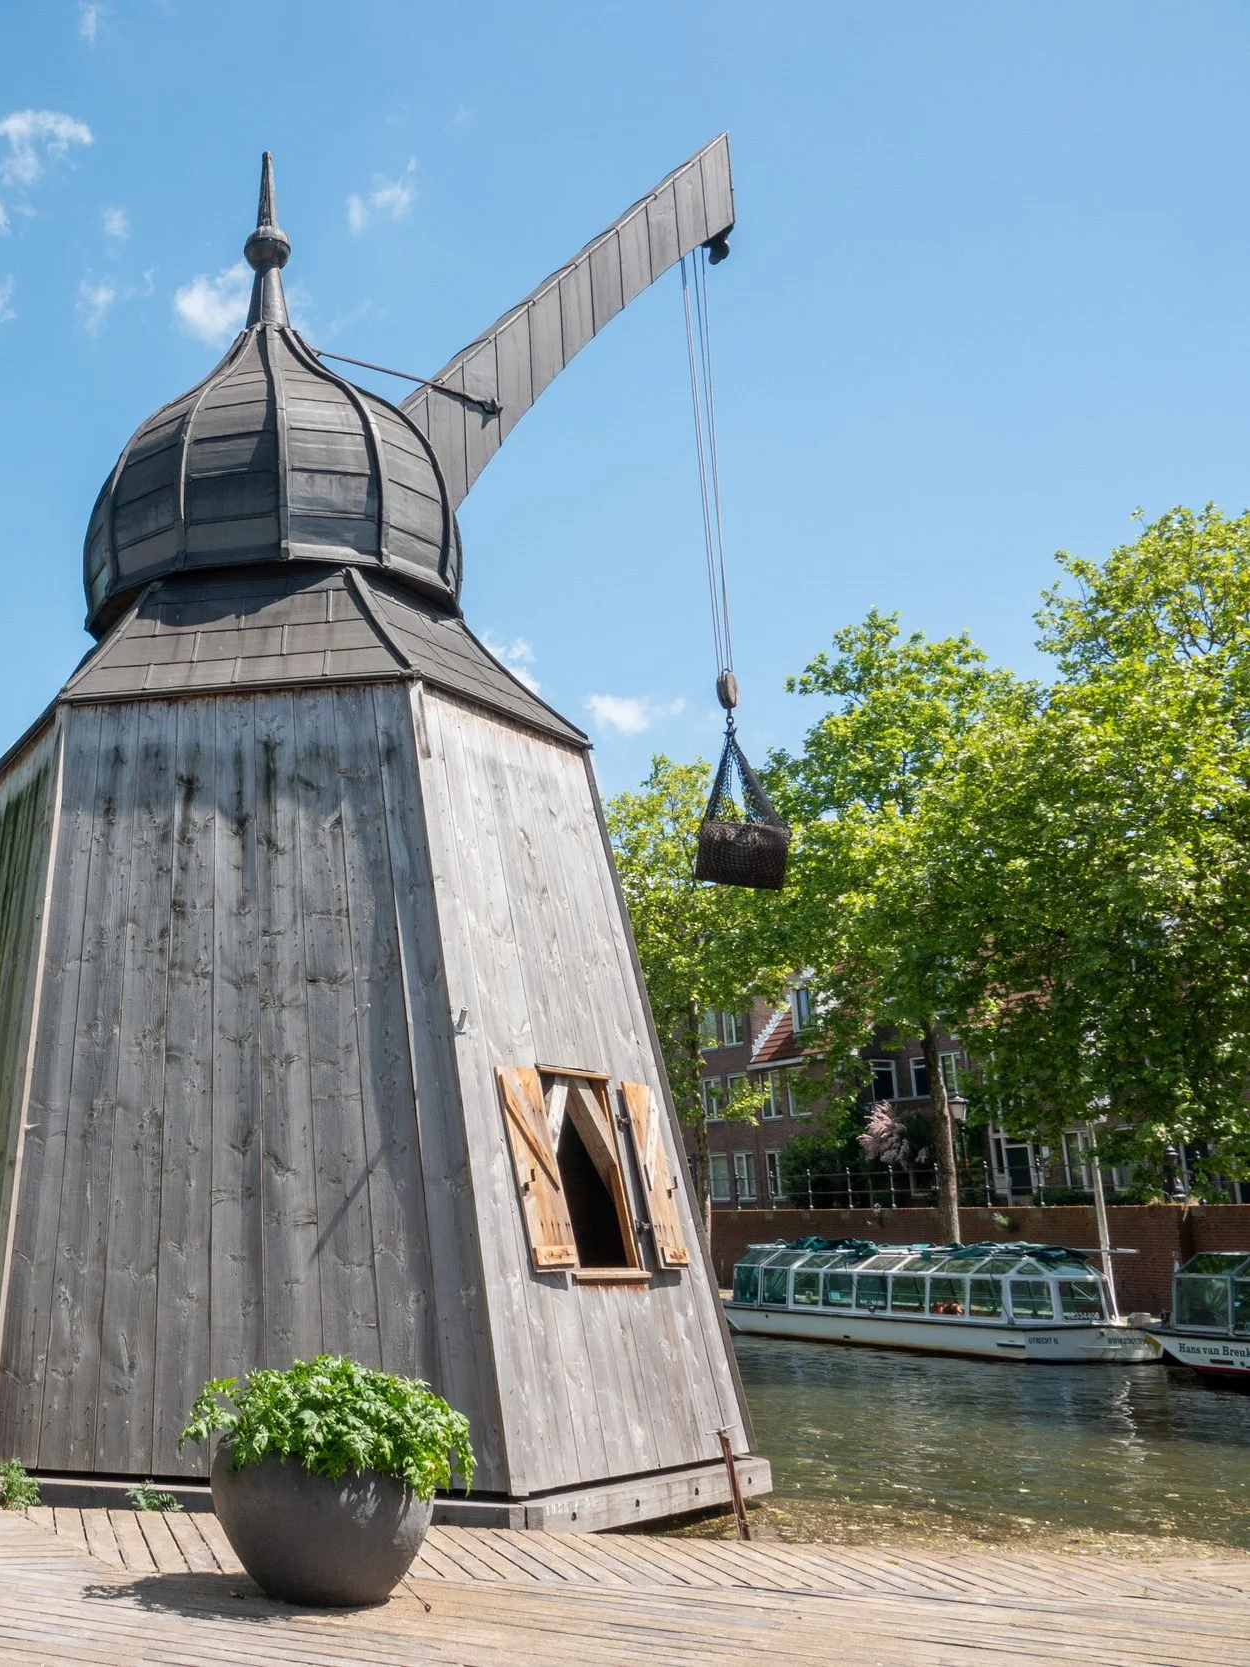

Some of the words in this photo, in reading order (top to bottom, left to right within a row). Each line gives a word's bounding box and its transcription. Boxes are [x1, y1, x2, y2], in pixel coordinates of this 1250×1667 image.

[1028, 1337, 1052, 1345] UTRECHT
[1178, 1342, 1201, 1354] Hans
[1202, 1347, 1219, 1355] van
